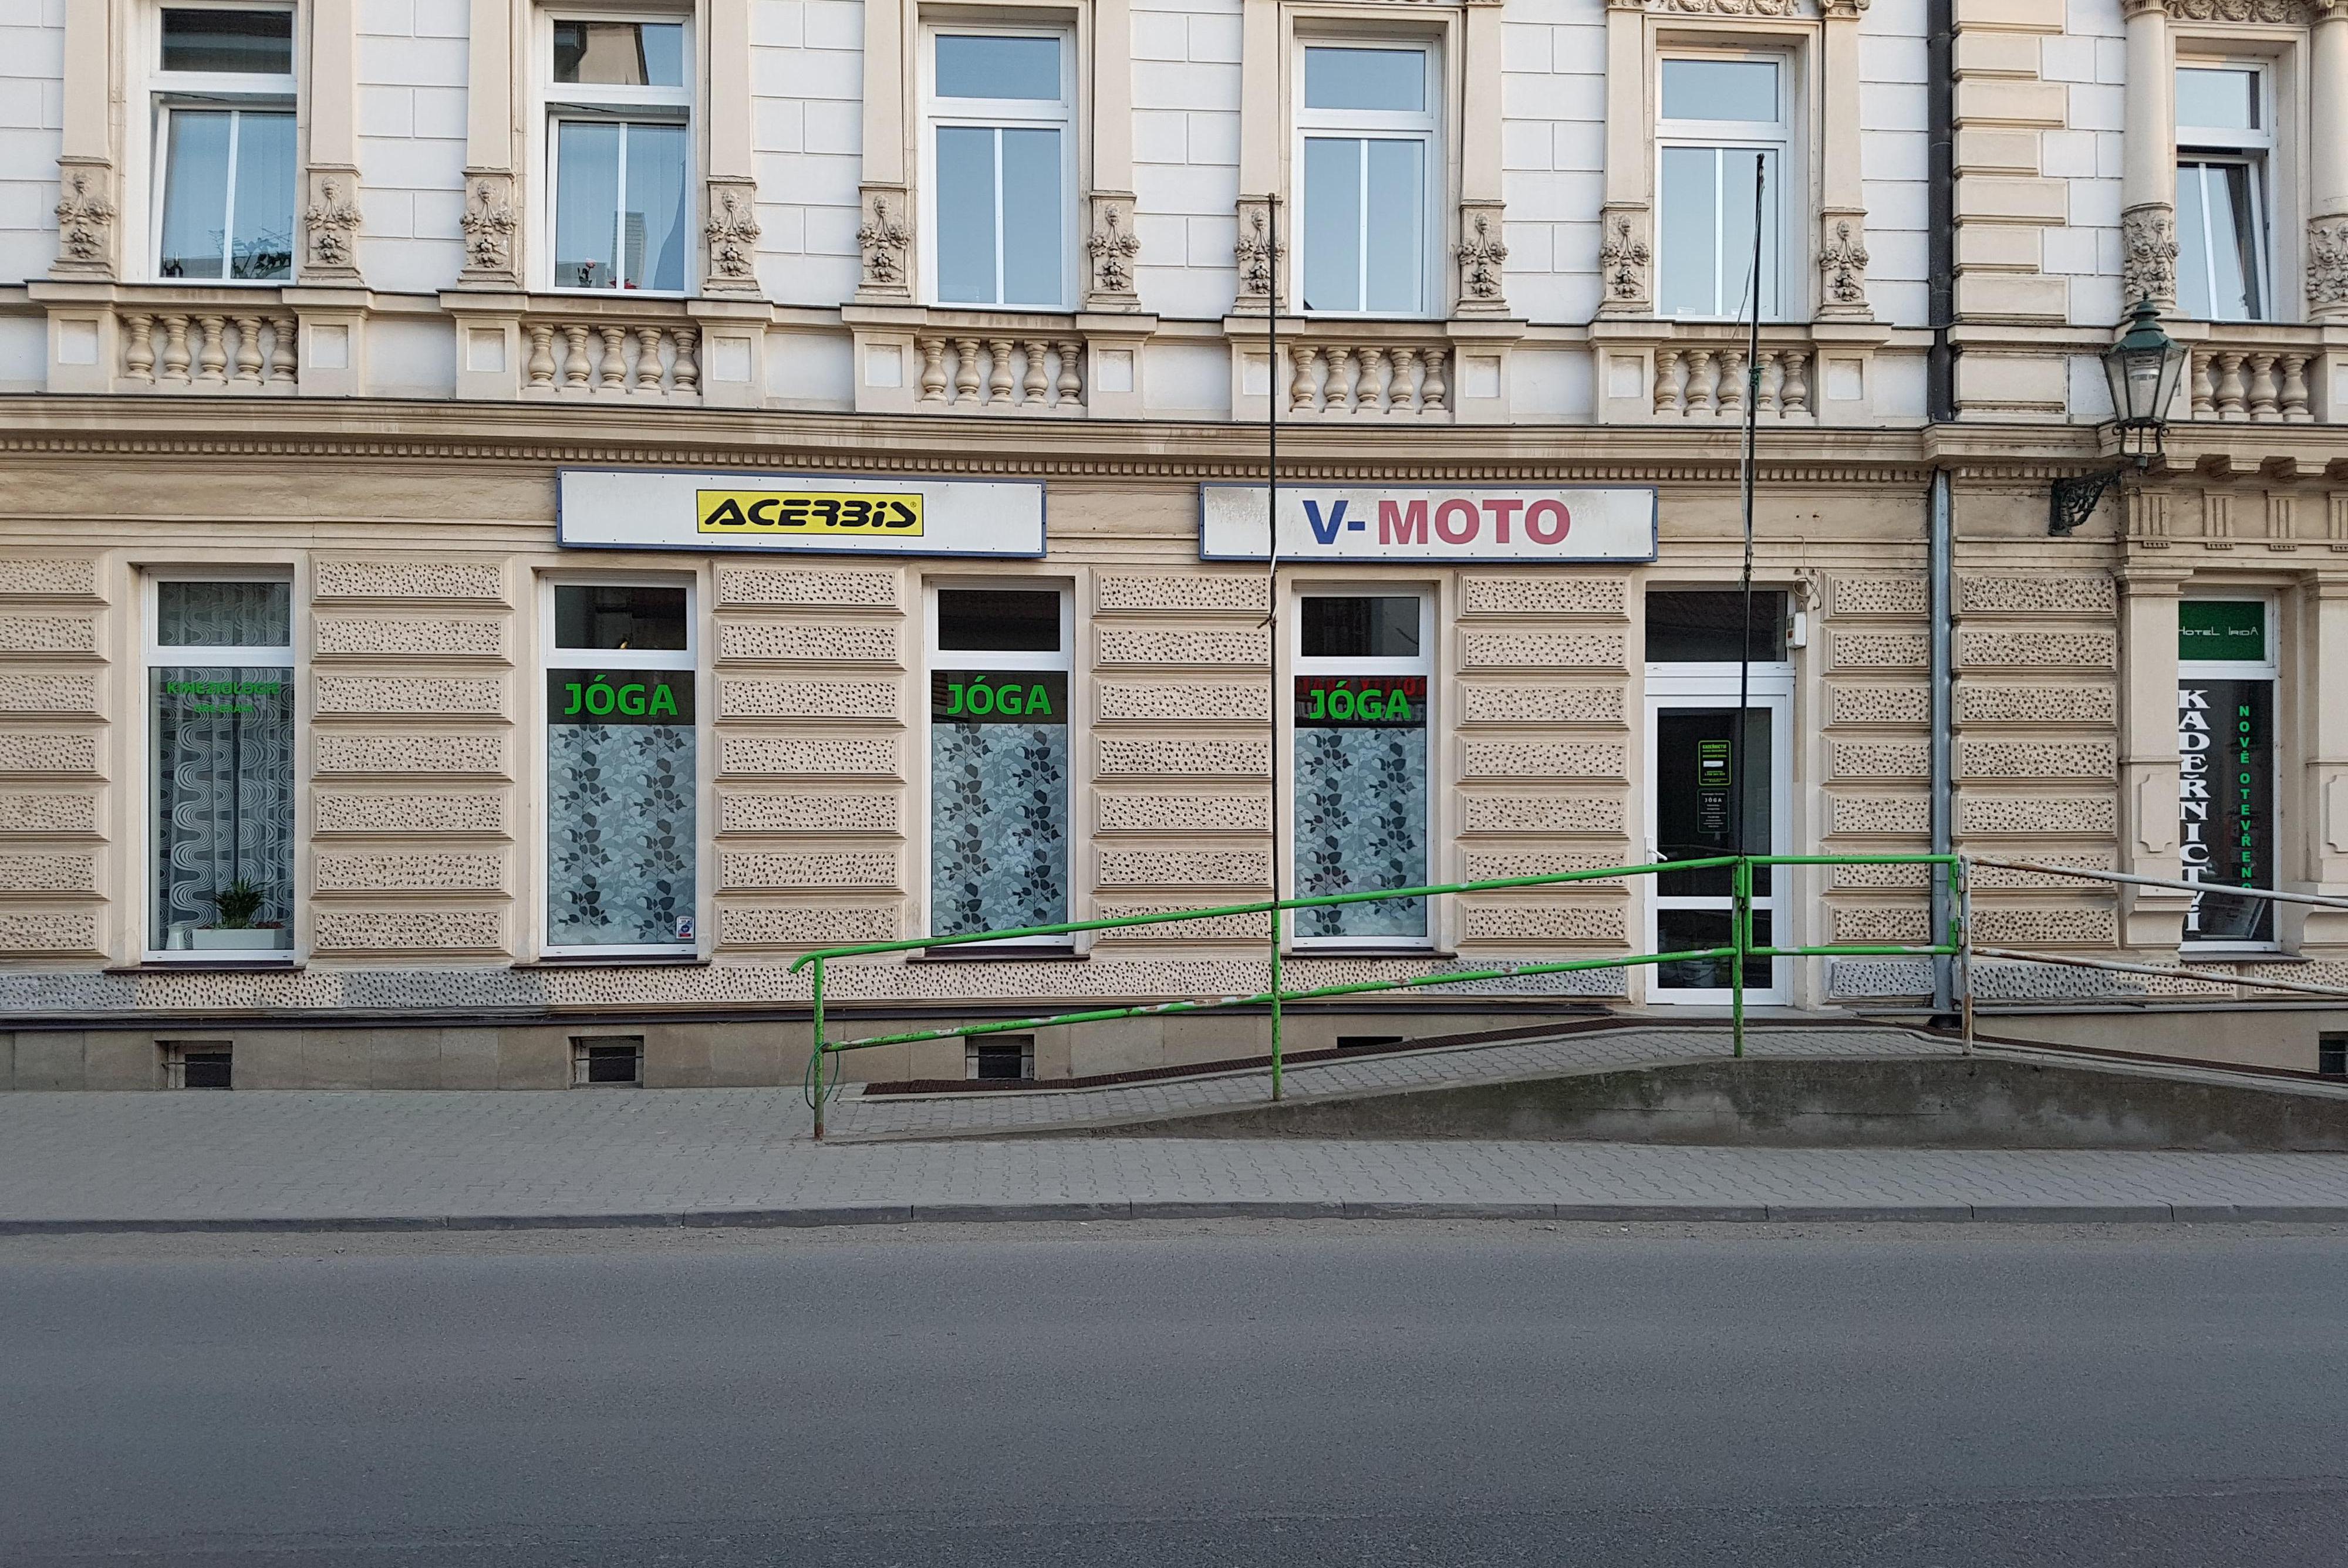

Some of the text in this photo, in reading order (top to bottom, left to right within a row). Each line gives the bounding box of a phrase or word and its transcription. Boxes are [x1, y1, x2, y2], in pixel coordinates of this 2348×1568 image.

[704, 498, 917, 528] ACERBIS
[564, 674, 679, 715] JÓGA
[947, 675, 1052, 715] JÓGA
[1309, 680, 1412, 719] JÓGA
[2239, 706, 2250, 763] NOVĚ
